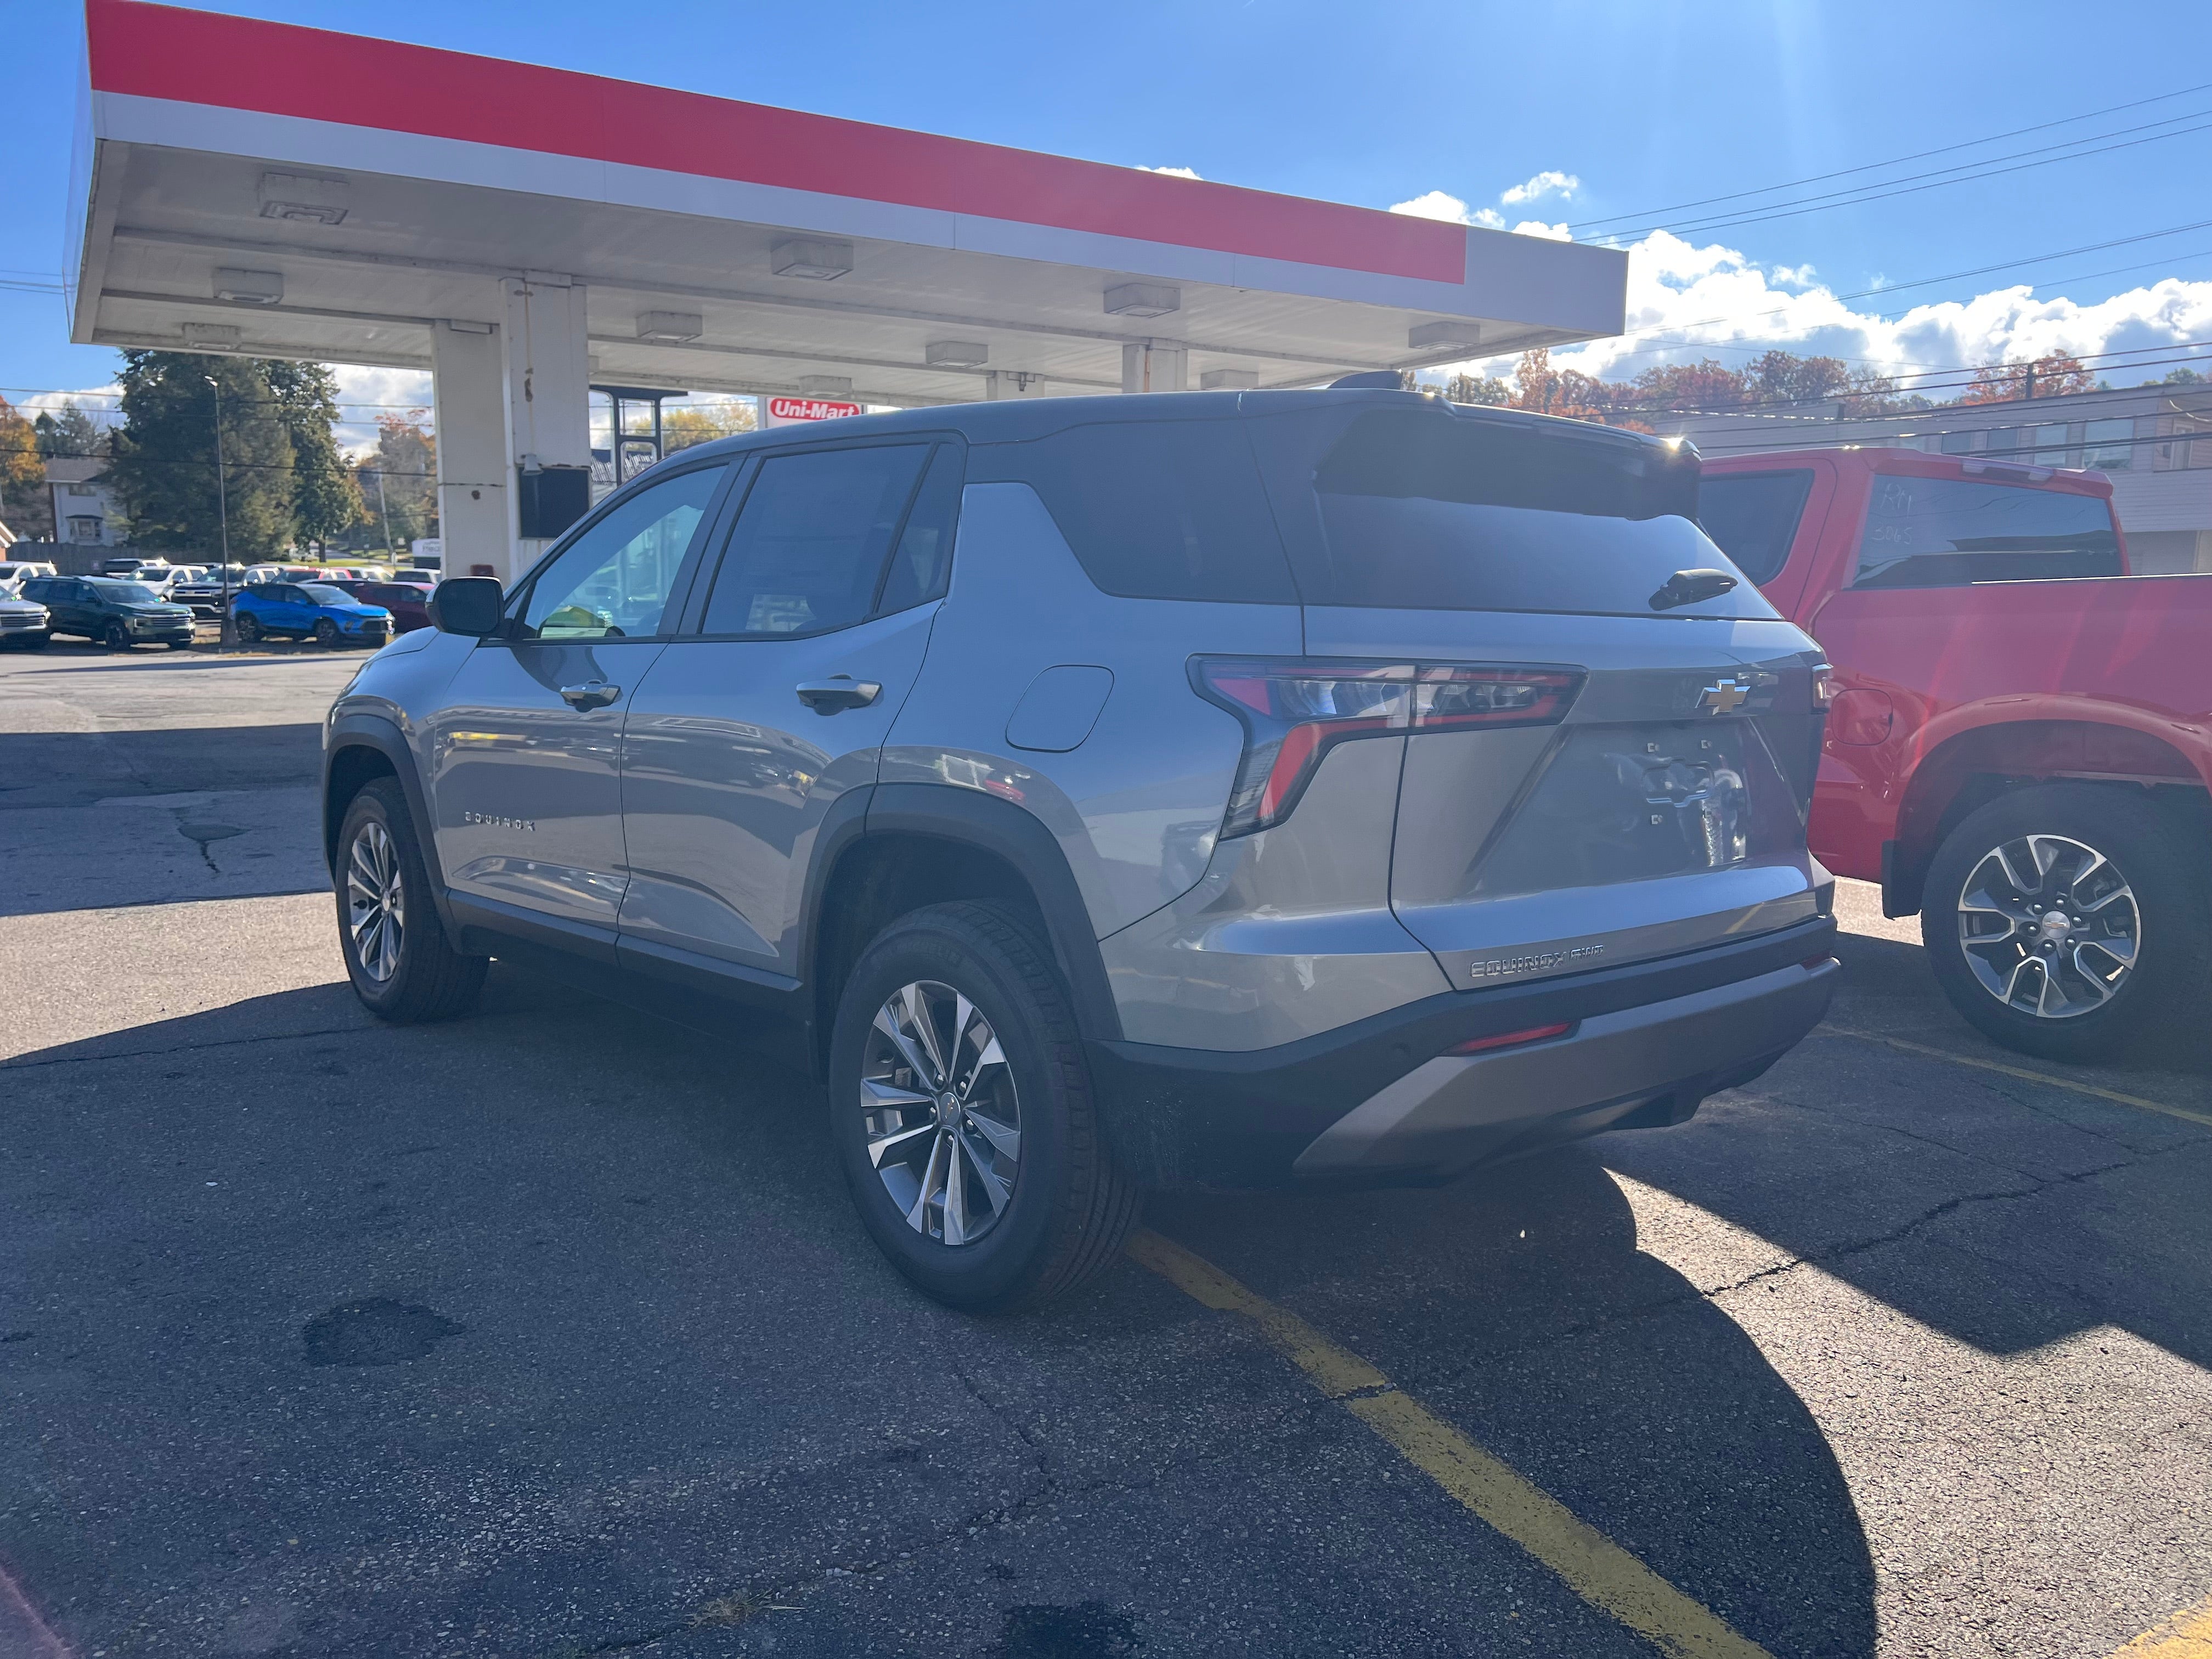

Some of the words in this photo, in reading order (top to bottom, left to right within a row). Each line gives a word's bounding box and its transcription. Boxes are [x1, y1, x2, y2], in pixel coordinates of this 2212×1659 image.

[774, 400, 855, 419] Uni-Mart
[465, 811, 536, 832] EQUINOX
[1469, 951, 1567, 978] EQUINOX
